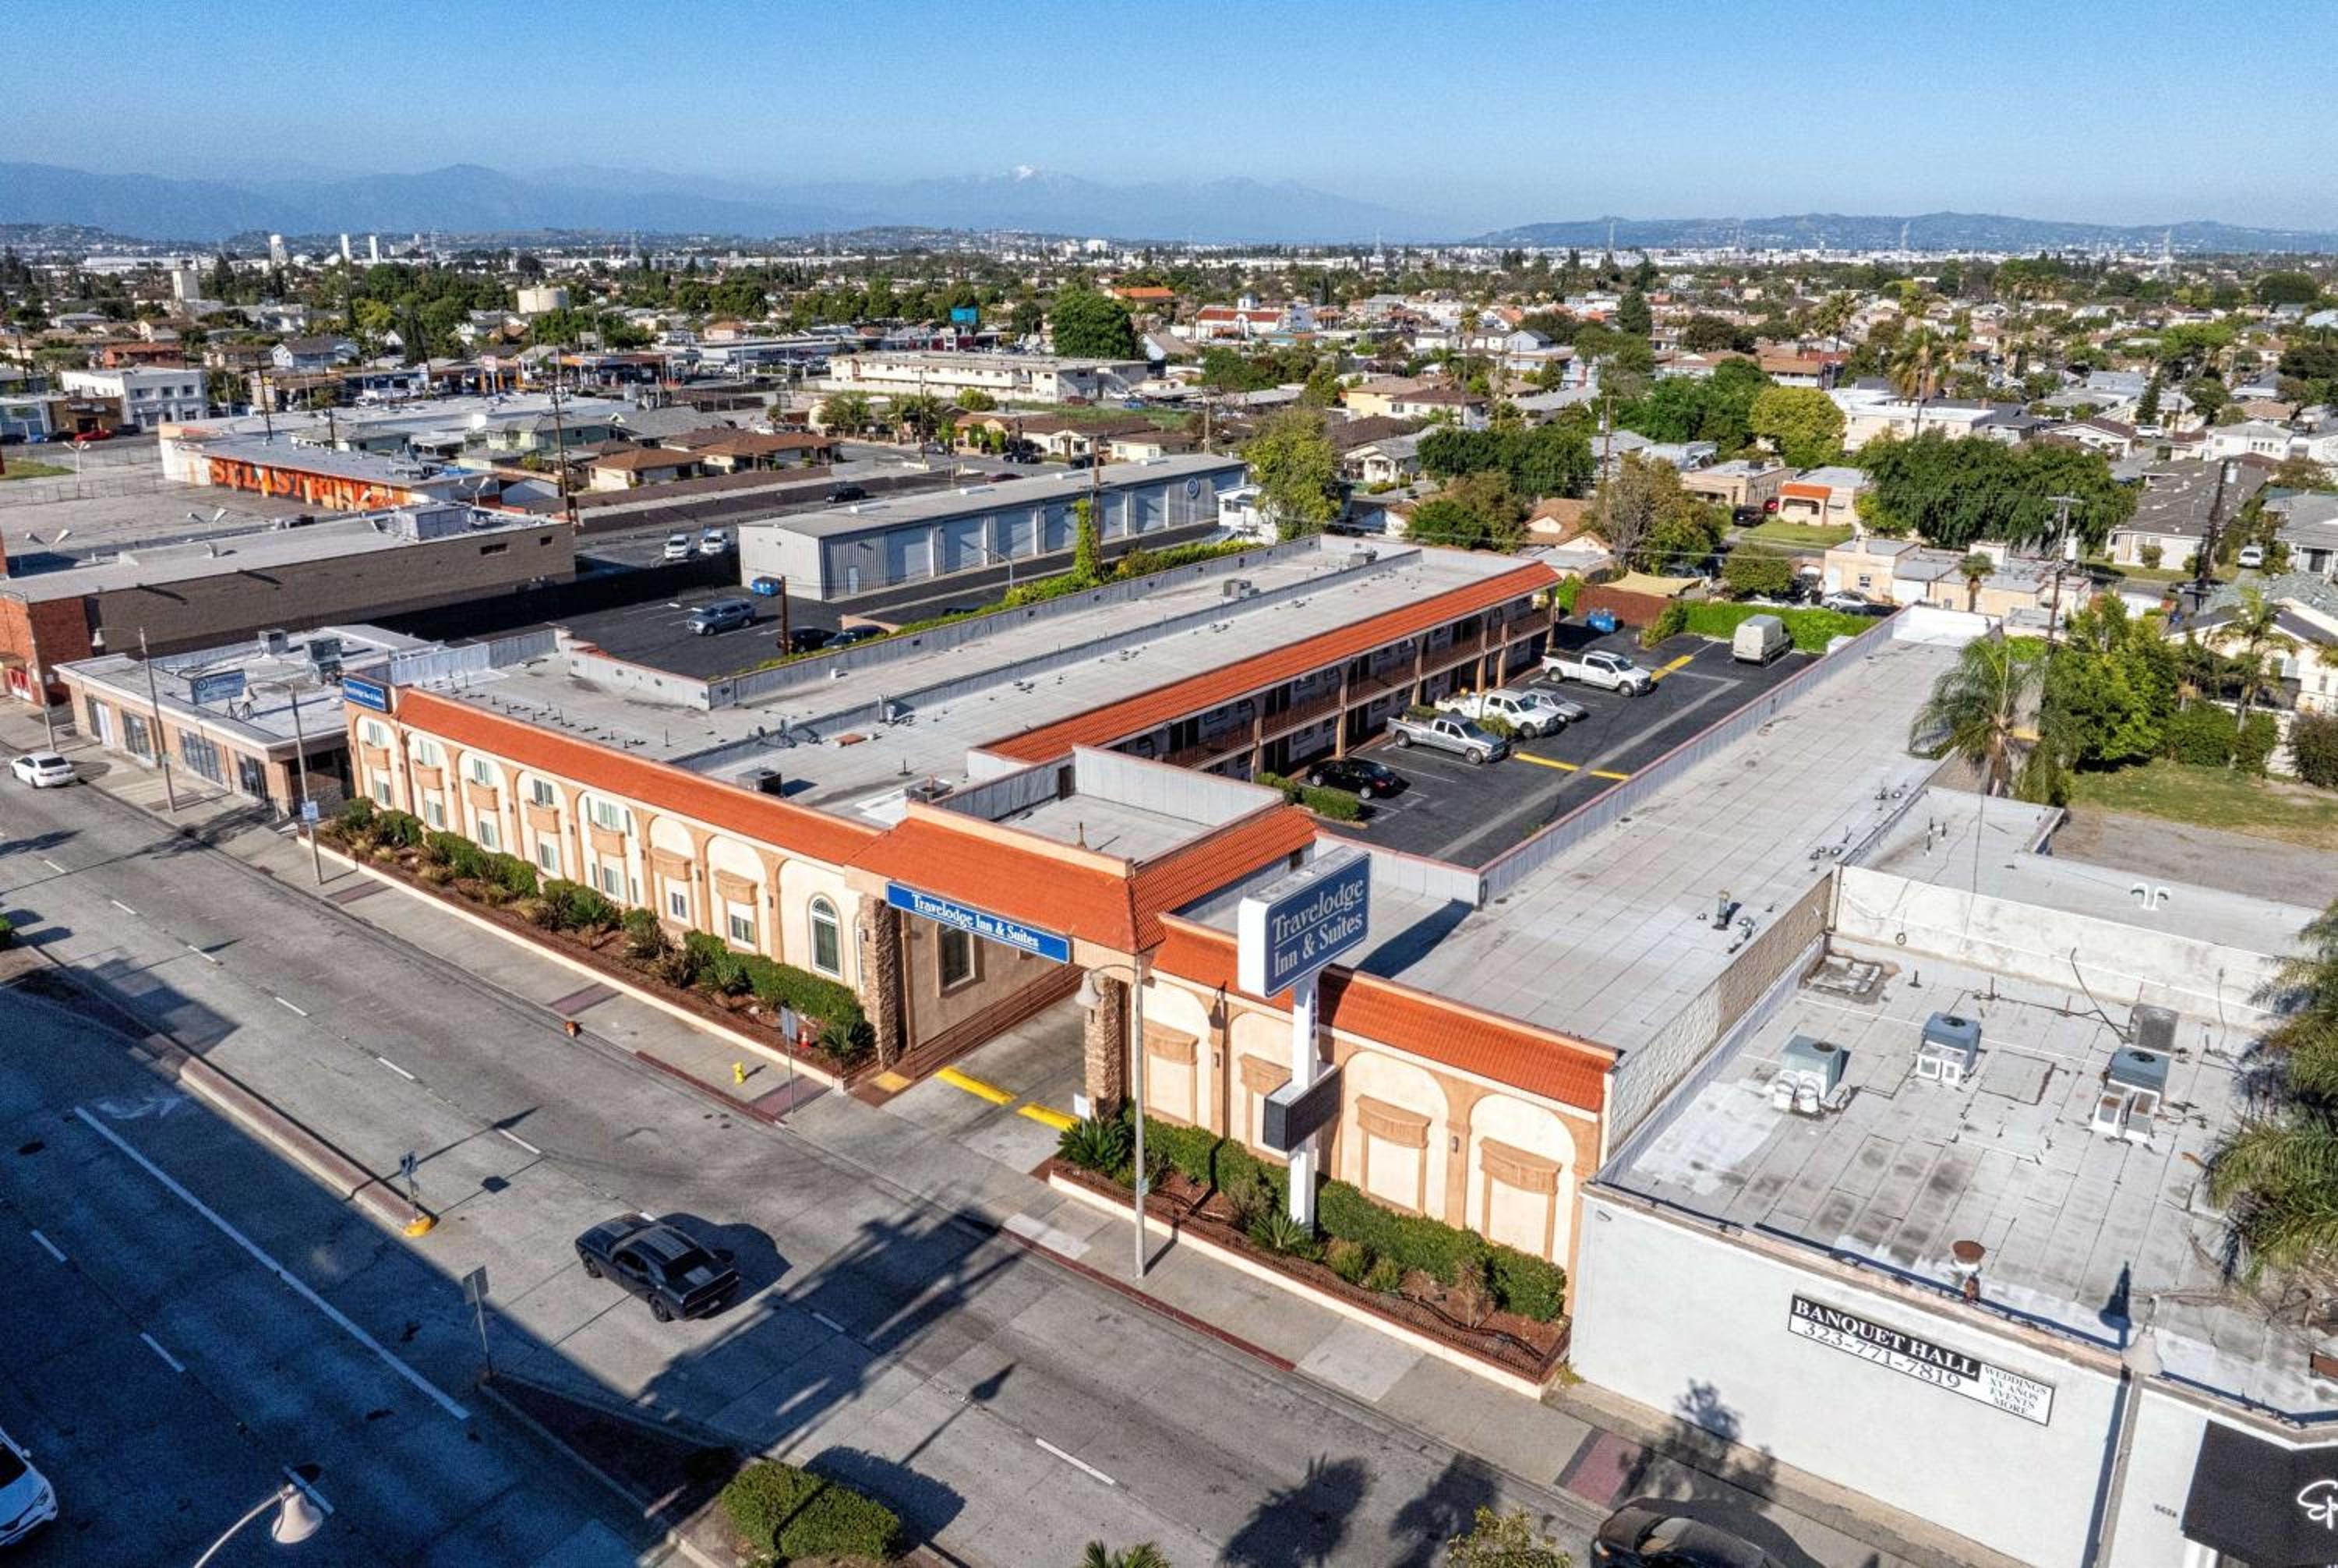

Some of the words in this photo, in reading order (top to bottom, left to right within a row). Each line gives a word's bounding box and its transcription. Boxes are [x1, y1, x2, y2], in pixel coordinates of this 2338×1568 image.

[912, 894, 973, 928] Travelodge
[976, 915, 992, 932] Inn
[995, 923, 1005, 936] &
[1007, 926, 1039, 947] Suites
[1272, 880, 1363, 944] Travelodge
[1275, 950, 1298, 977] Inn
[1302, 933, 1315, 959] &
[1319, 913, 1363, 950] Suites
[1795, 1298, 1905, 1350] BANQUET
[1910, 1341, 1977, 1376] HALL
[1804, 1322, 1961, 1388] 323-771-7819
[1985, 1366, 2047, 1397] WEDDINGS
[1990, 1387, 2035, 1410] EVENTS
